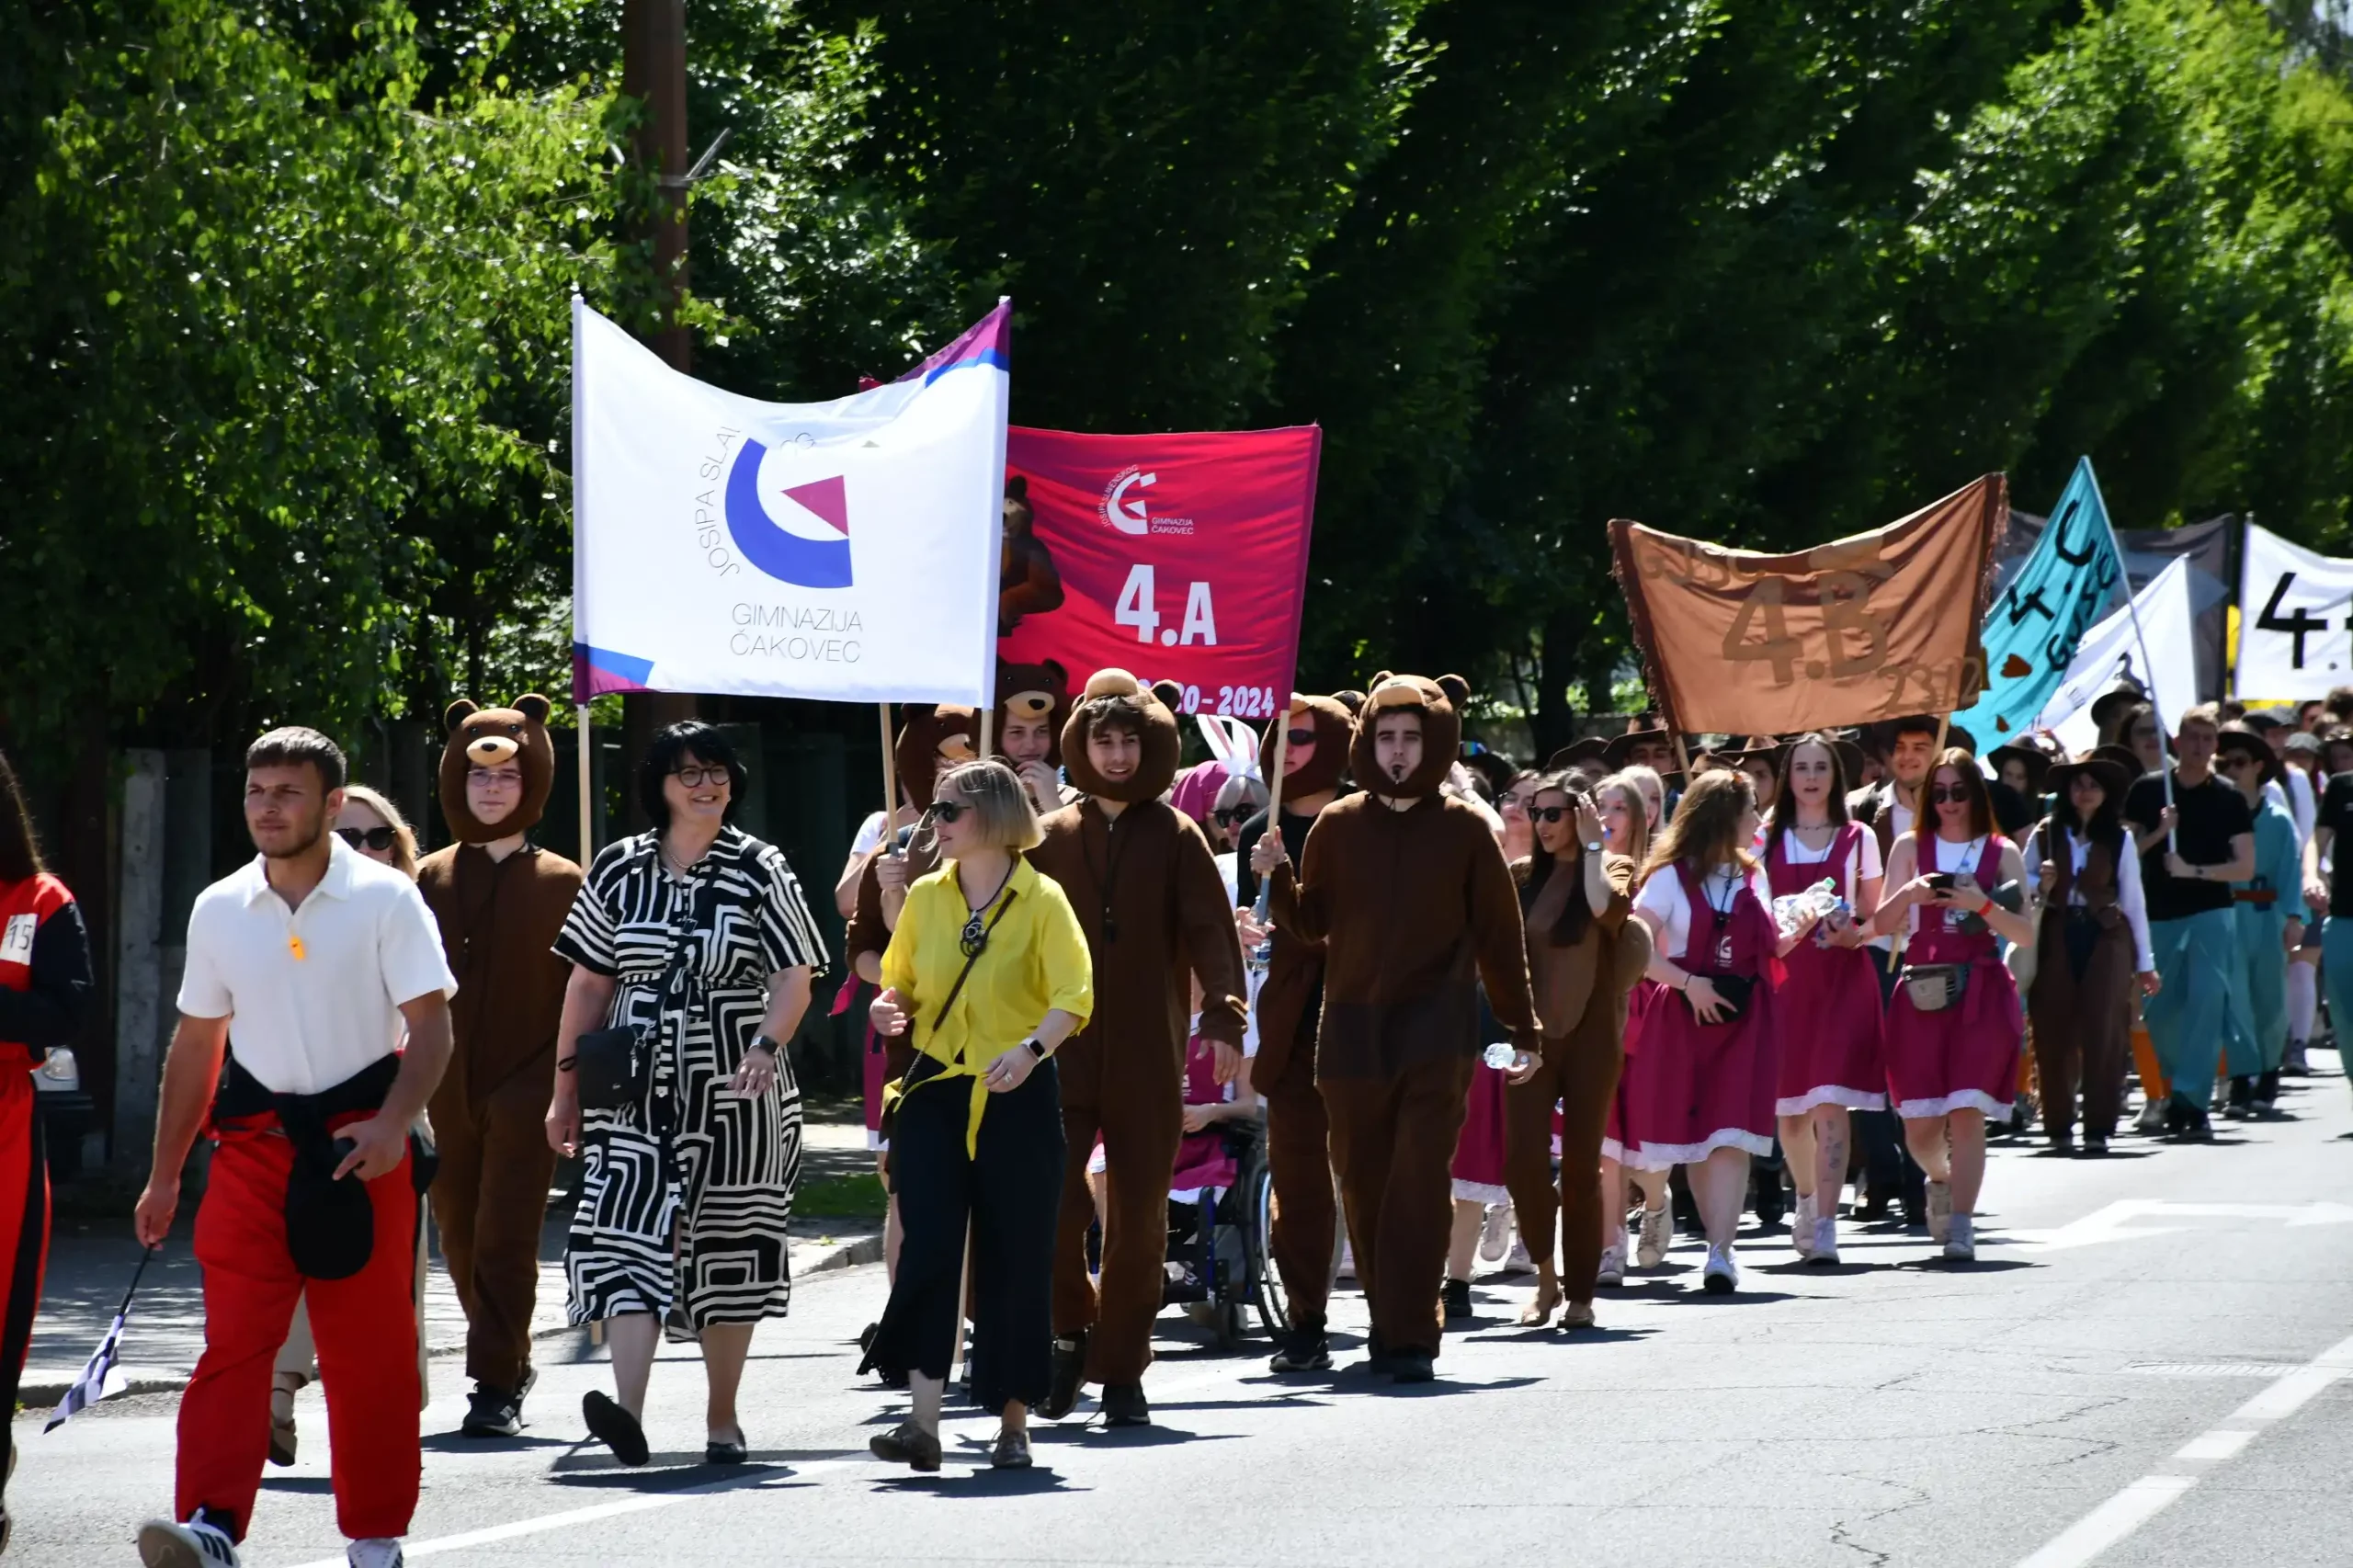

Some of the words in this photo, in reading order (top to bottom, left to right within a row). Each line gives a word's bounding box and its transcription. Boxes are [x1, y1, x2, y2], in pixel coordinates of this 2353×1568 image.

[695, 489, 741, 577] JOSIPA
[1151, 517, 1194, 527] GIMNAZIJA
[730, 628, 861, 664] ČAKOVEC
[732, 602, 863, 632] GIMNAZIJA
[1114, 563, 1217, 647] 4.A
[1721, 570, 1888, 685] 4.B
[2255, 571, 2353, 671] 4.
